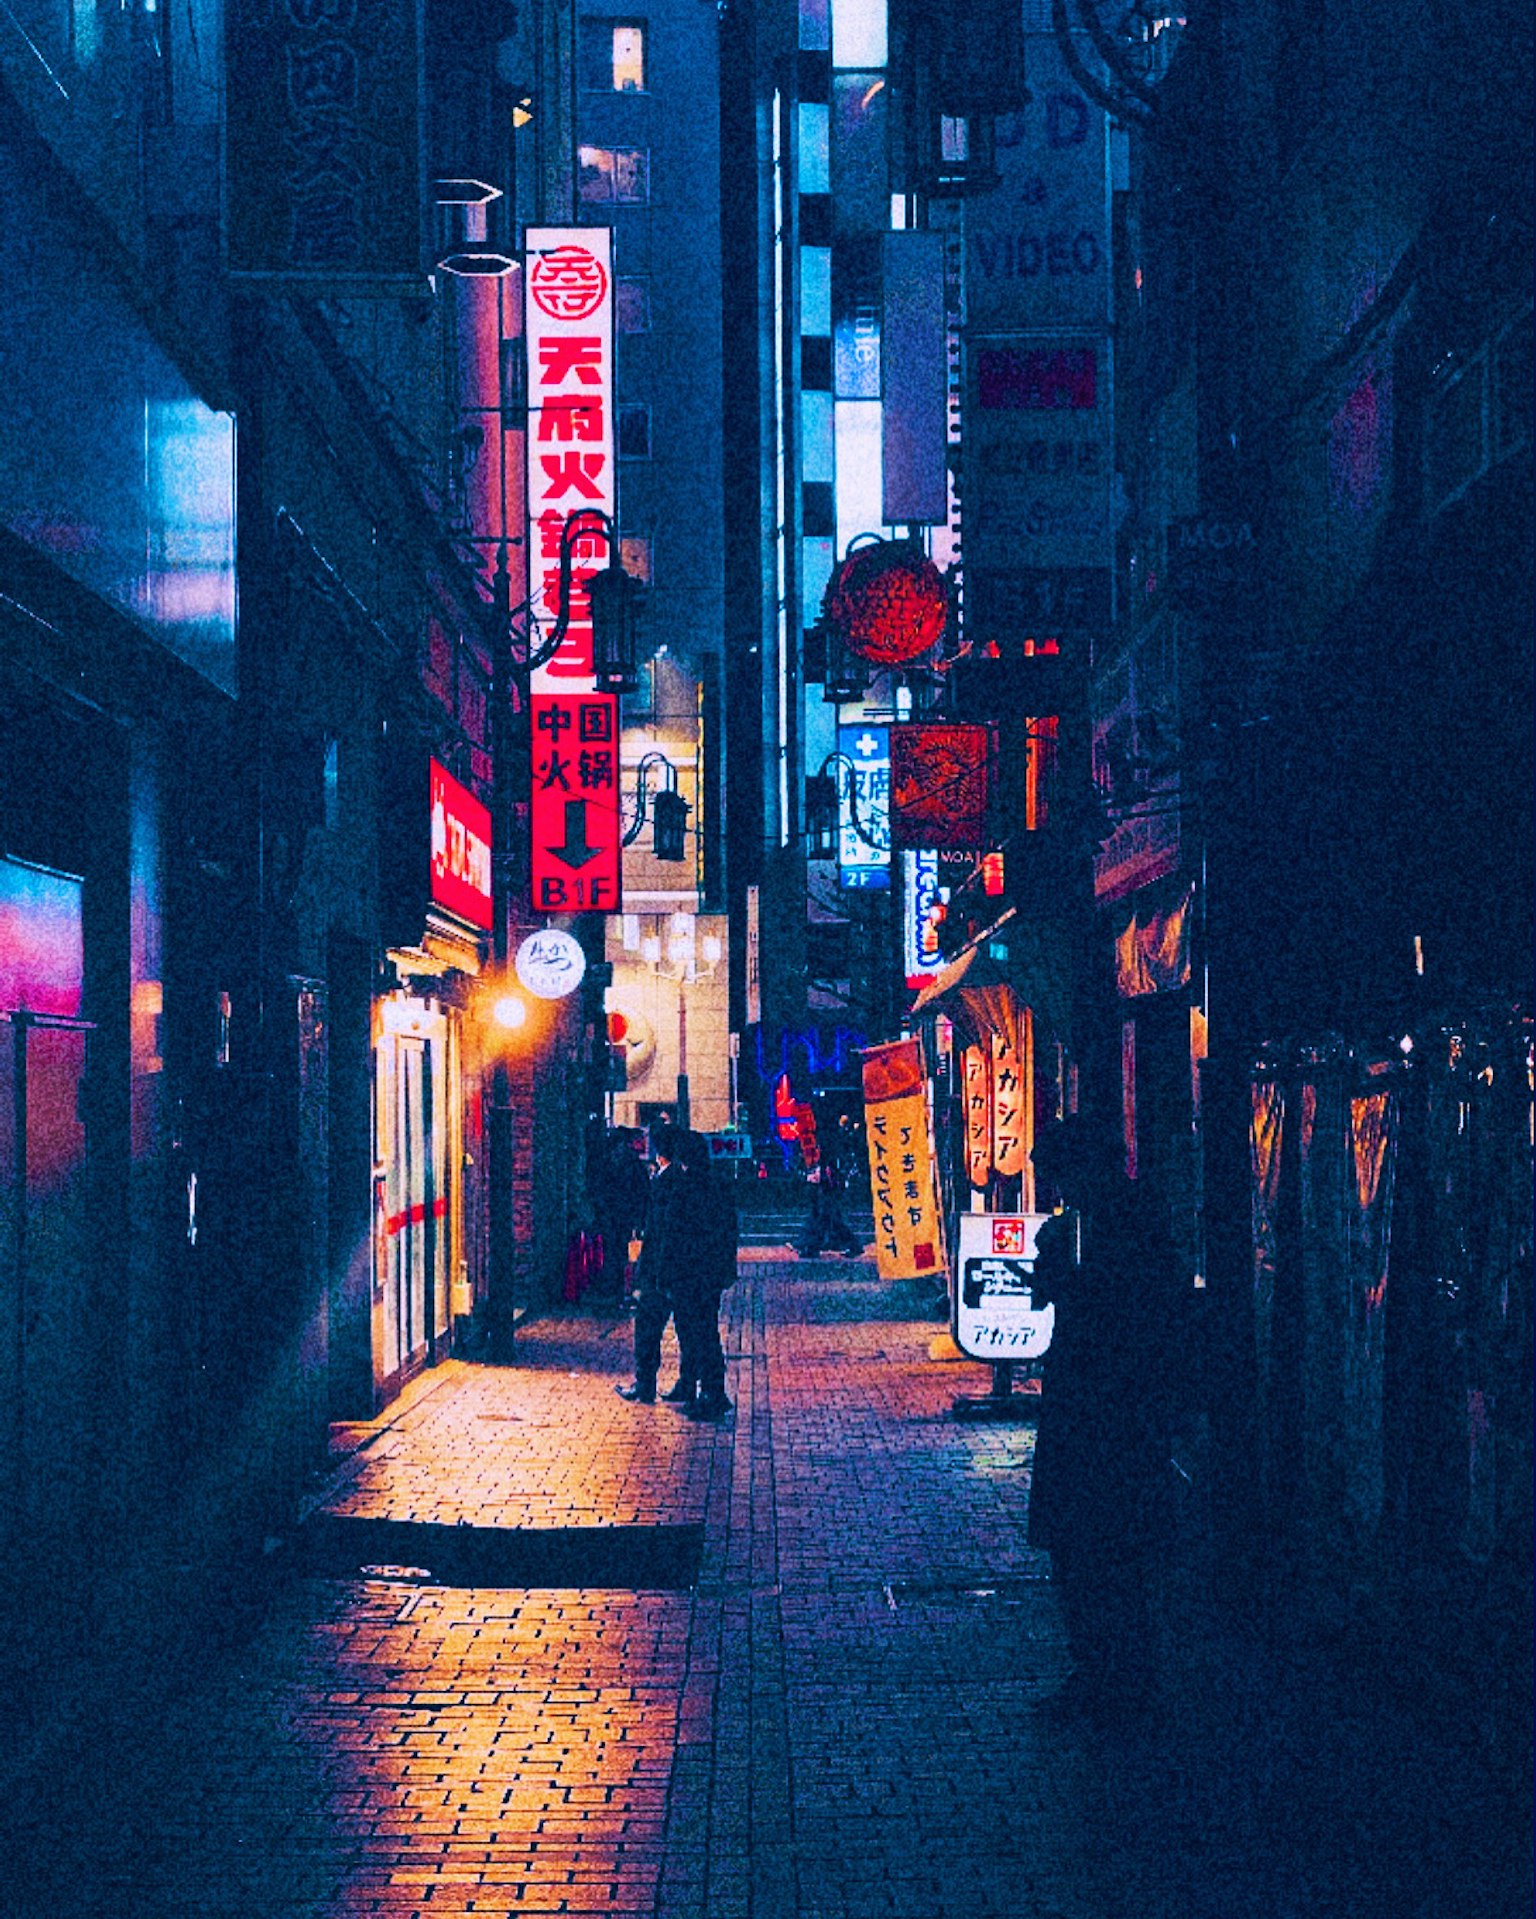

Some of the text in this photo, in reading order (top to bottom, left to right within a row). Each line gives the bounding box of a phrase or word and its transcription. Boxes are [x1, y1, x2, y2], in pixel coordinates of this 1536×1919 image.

[974, 229, 1100, 278] VIDEO
[538, 702, 612, 743] 中国
[541, 877, 611, 906] B1F
[846, 870, 870, 886] 2F
[969, 1063, 987, 1168] アカシア
[974, 1324, 1036, 1346] アカシア
